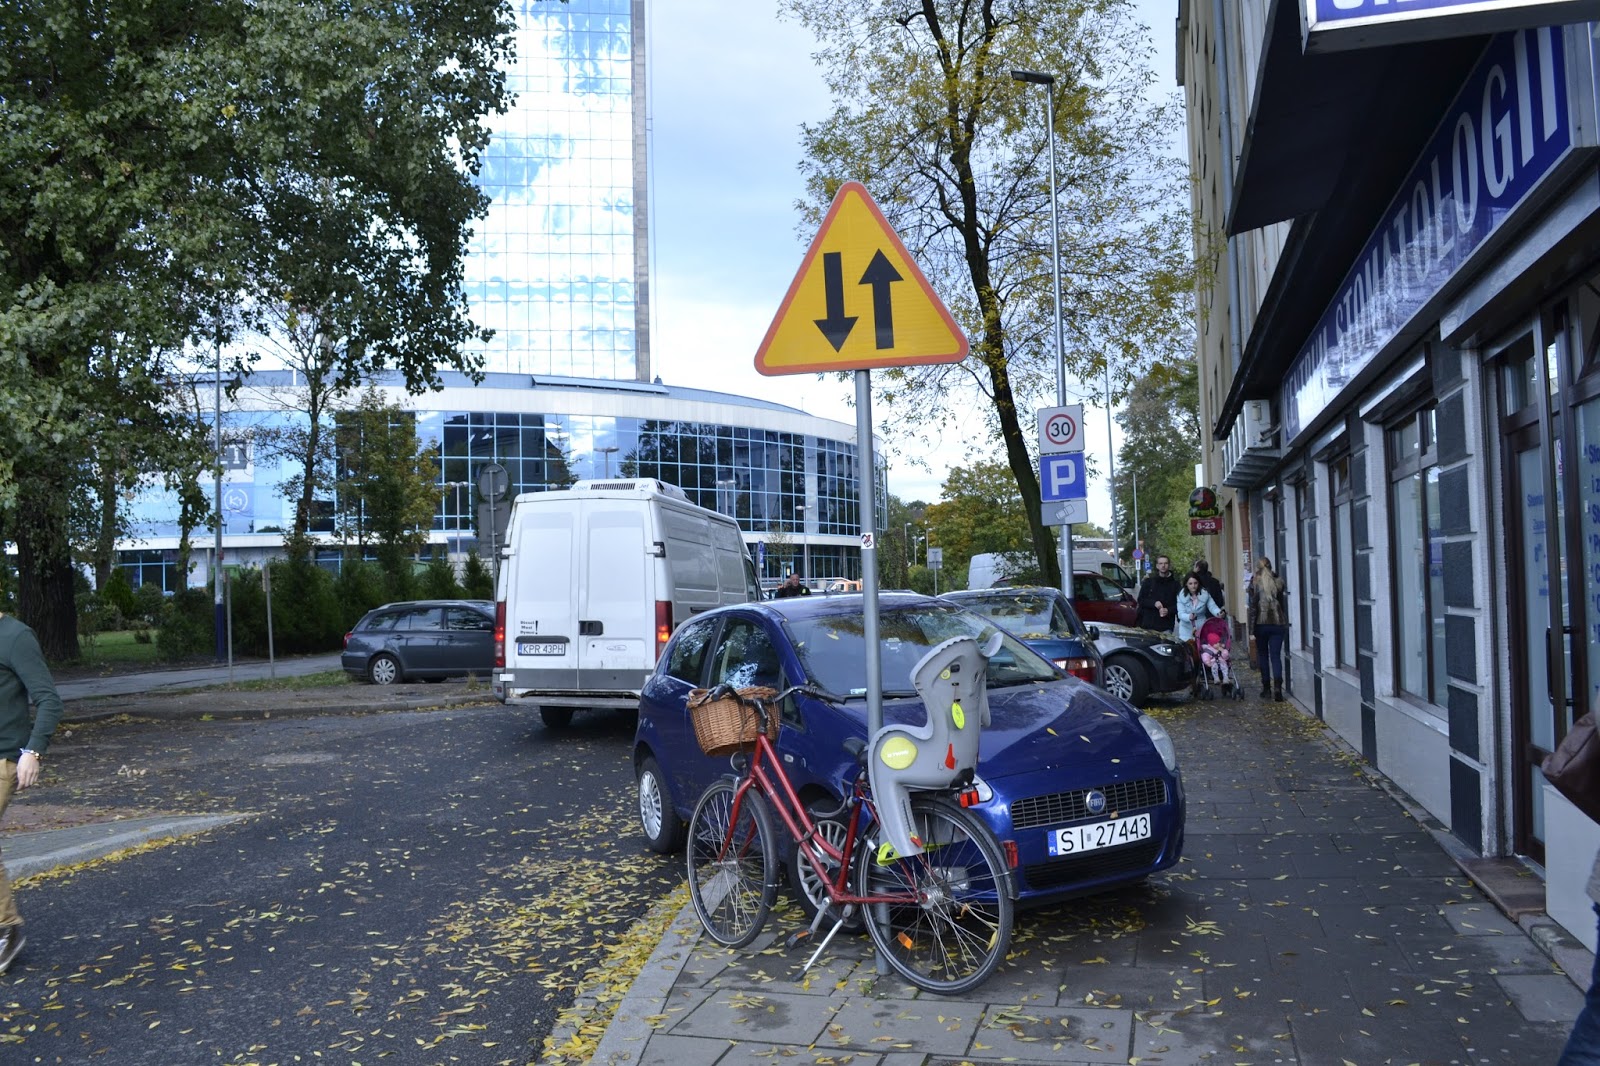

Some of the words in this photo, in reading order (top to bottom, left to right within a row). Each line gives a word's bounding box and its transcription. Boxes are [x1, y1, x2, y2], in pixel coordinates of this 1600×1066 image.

[1050, 421, 1071, 438] 30
[1050, 459, 1076, 496] P
[1196, 522, 1216, 530] 6-23
[523, 644, 541, 654] KPR
[543, 644, 564, 654] 43PH
[1090, 797, 1104, 807] FIAT
[1060, 828, 1085, 852] SI
[1095, 816, 1149, 847] 27443
